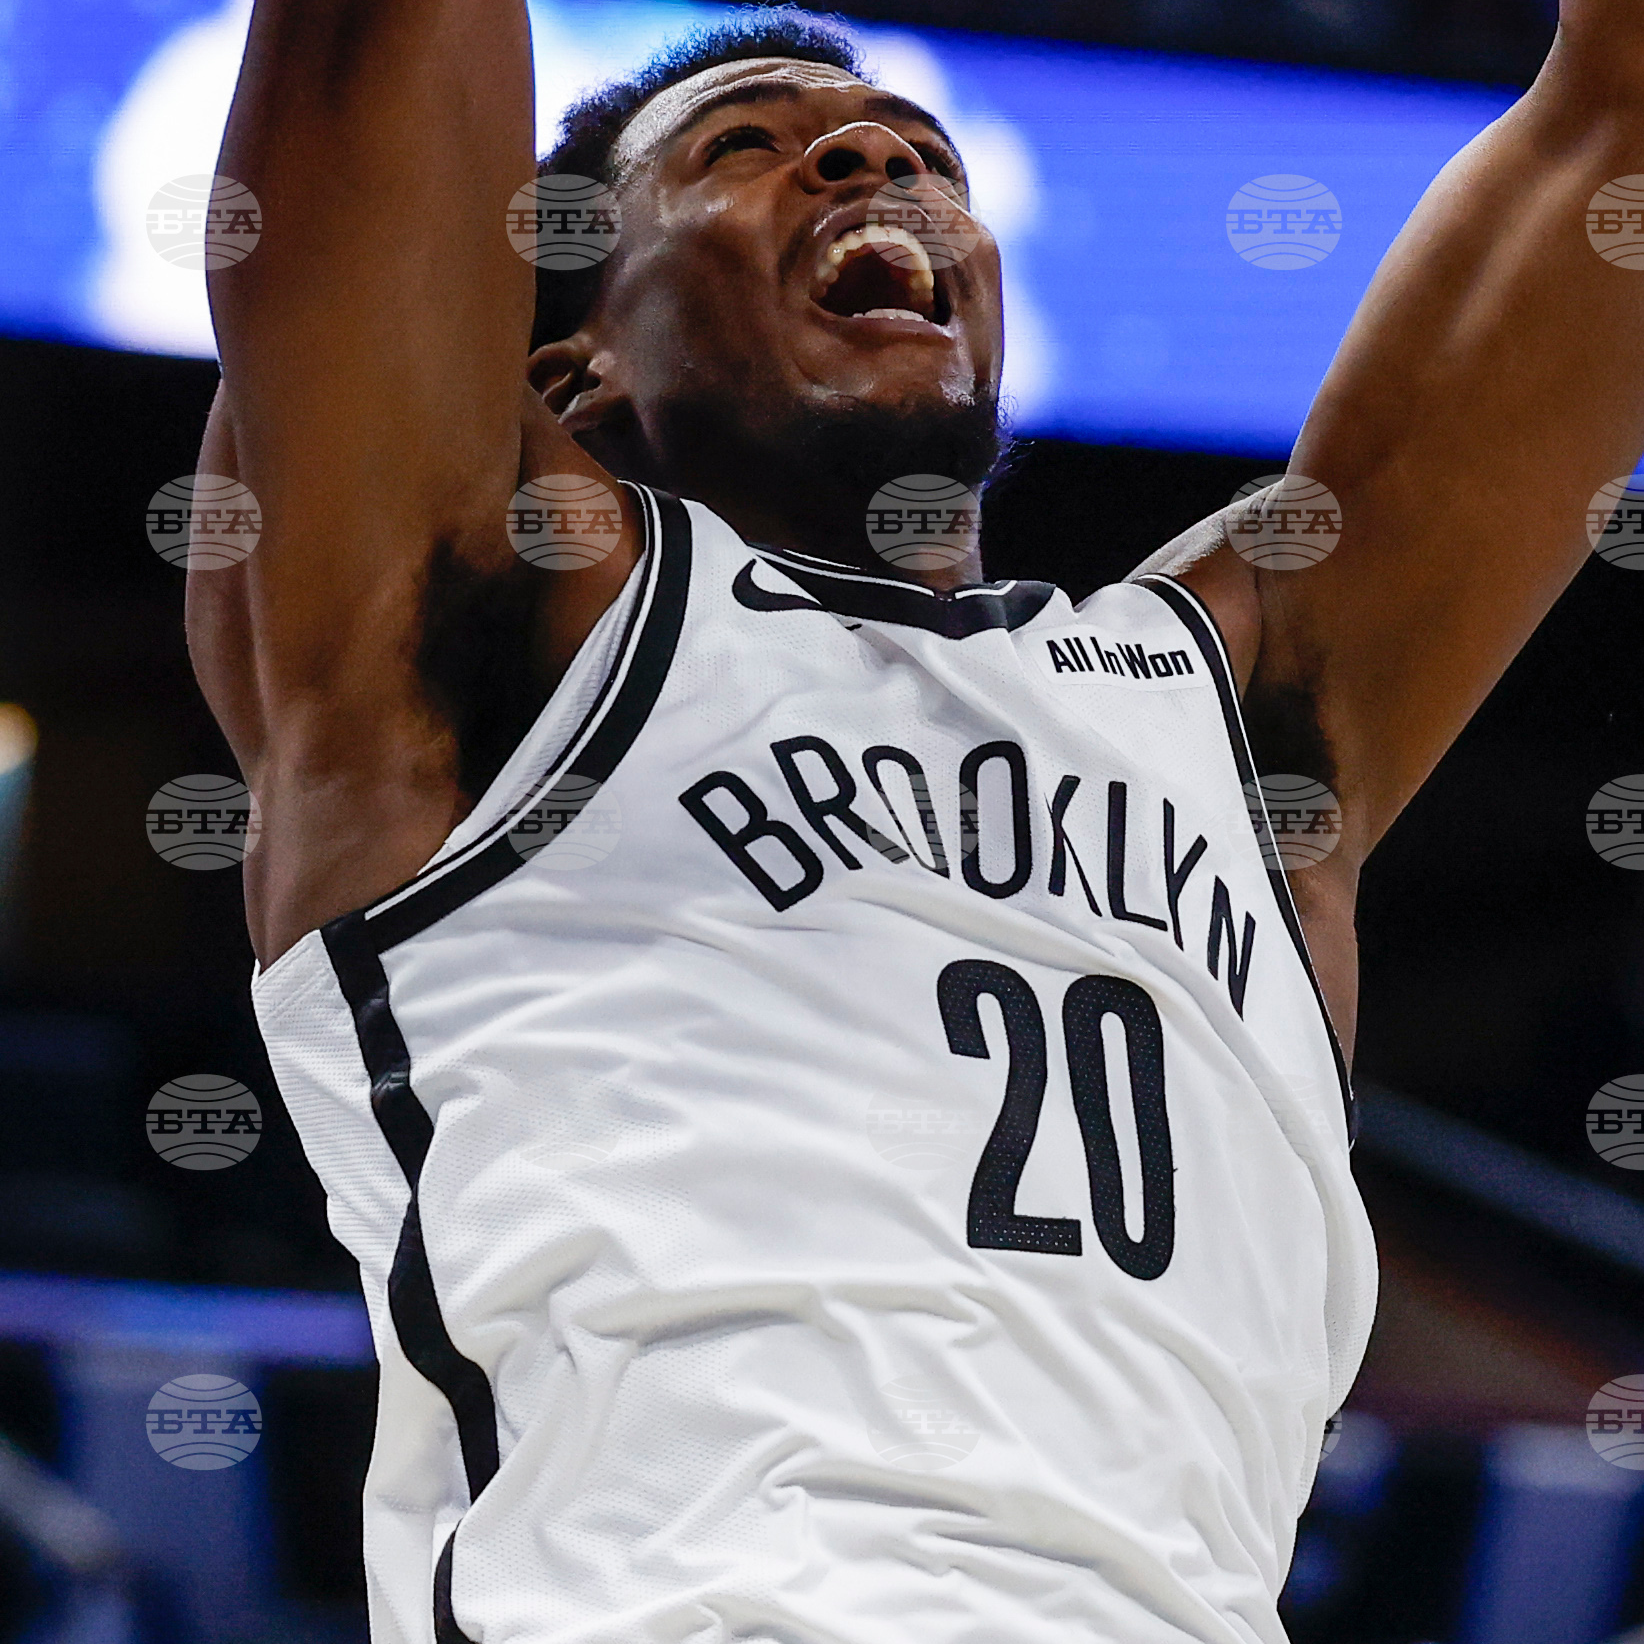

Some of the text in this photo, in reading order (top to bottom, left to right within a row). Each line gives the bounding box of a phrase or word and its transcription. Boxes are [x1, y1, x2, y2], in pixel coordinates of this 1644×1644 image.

[1046, 636, 1195, 679] All In Won
[677, 734, 1257, 1022] BROOKLYN
[936, 958, 1176, 1282] 20
